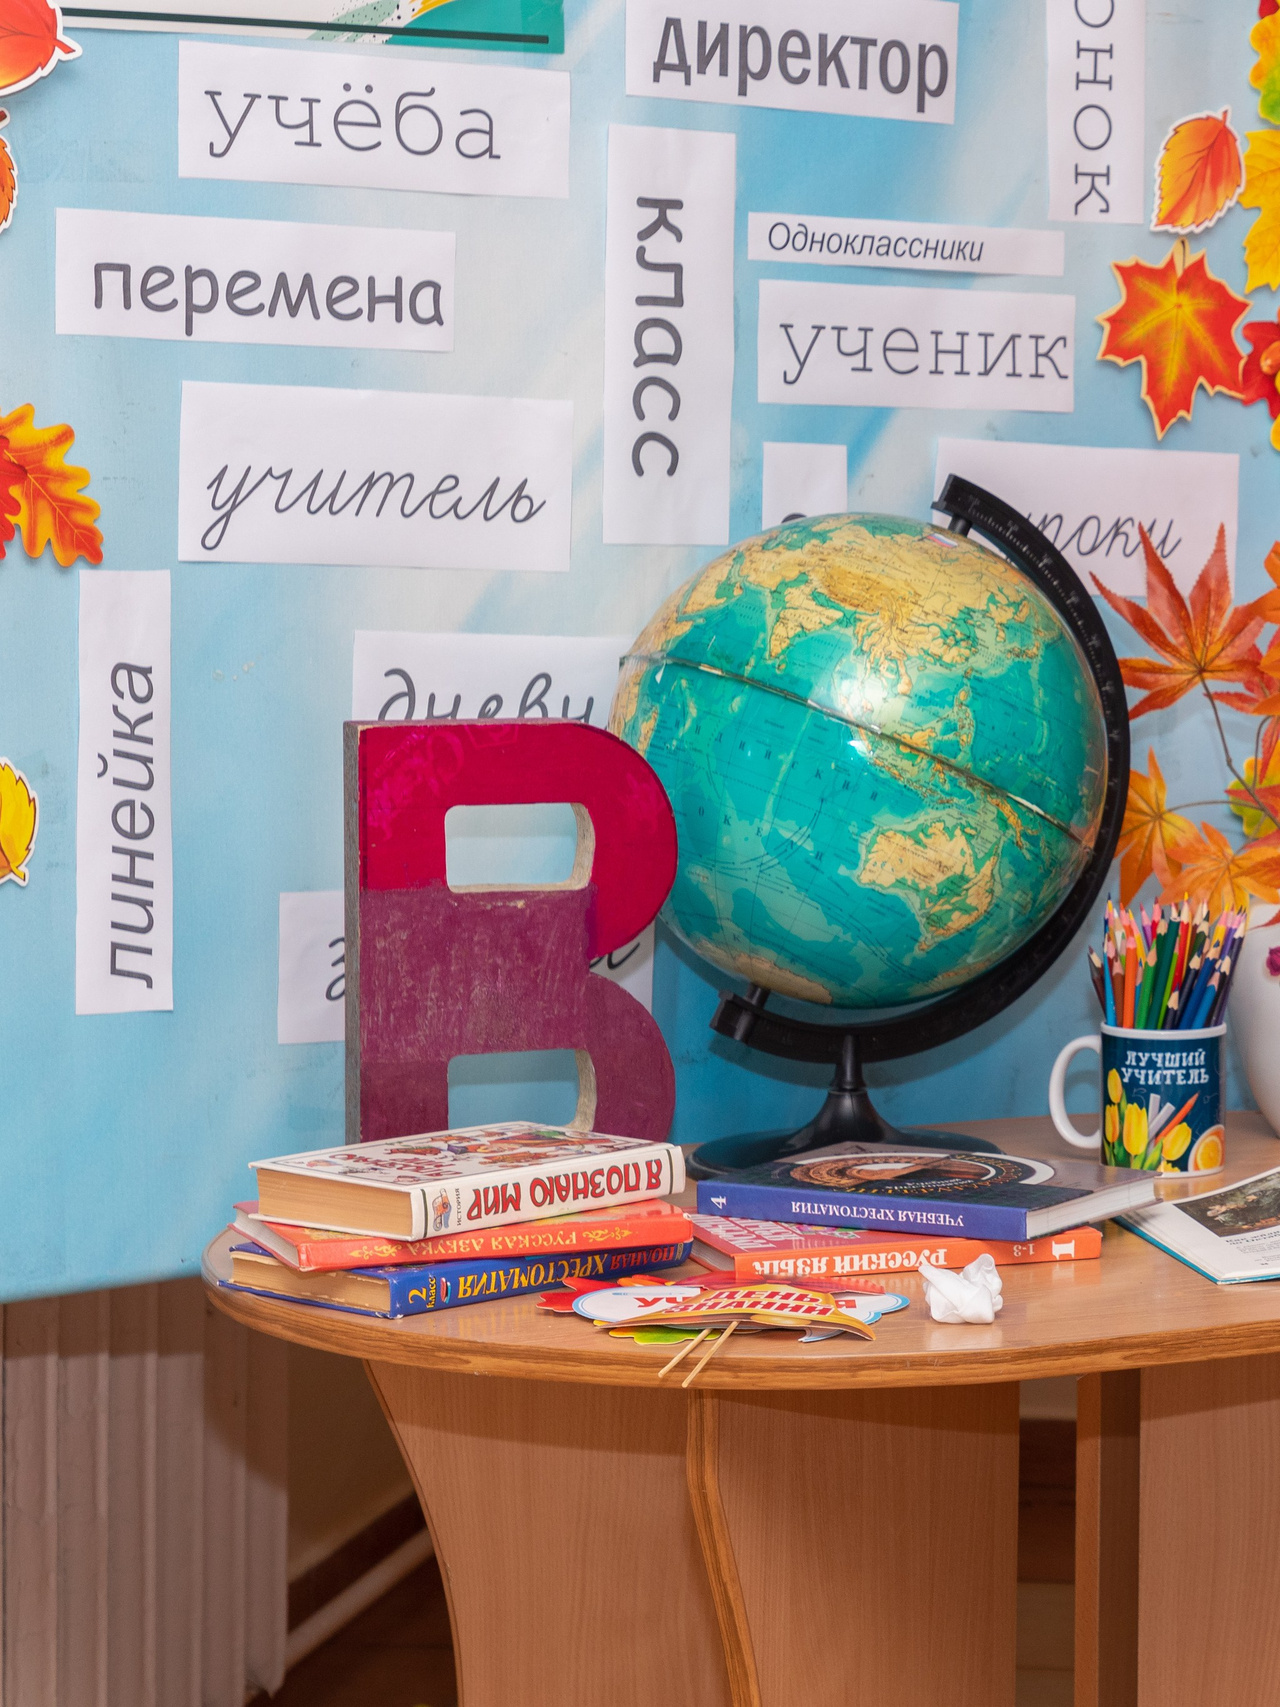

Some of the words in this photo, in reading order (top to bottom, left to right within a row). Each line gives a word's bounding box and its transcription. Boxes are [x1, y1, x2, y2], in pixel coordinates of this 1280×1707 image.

[652, 16, 948, 114] директор
[204, 82, 501, 160] учёба
[768, 221, 984, 263] Одноклассники
[93, 262, 444, 336] перемена
[631, 196, 684, 477] класс
[779, 323, 1069, 385] ученик
[200, 464, 546, 550] учитель
[1027, 511, 1183, 559] роки
[97, 661, 155, 989] линейка
[1125, 1049, 1206, 1068] ЛУЧШИЙ
[1121, 1068, 1210, 1086] УЧИТЕЛЬ
[529, 1163, 641, 1208] ПОЗНАЮ
[645, 1158, 663, 1190] Я
[467, 1180, 521, 1220] МИР
[710, 1196, 727, 1209] 4
[791, 1201, 894, 1220] ХРЕСТОМАТИЯ
[897, 1210, 964, 1227] УЧЕБНАЯ
[406, 1238, 483, 1257] АЗБУКА
[492, 1231, 577, 1250] РУССКАЯ
[1013, 1243, 1035, 1257] 1-3
[610, 1245, 675, 1270] ПОЛНАЯ
[752, 1257, 829, 1275] ЯЗЫК
[833, 1248, 948, 1274] РУССКИЙ
[457, 1253, 608, 1299] ХРЕСТОМАТИЯ
[408, 1287, 427, 1304] 2
[663, 1300, 835, 1317] ЗНАНИЙ
[704, 1290, 823, 1304] ДЕНЬ
